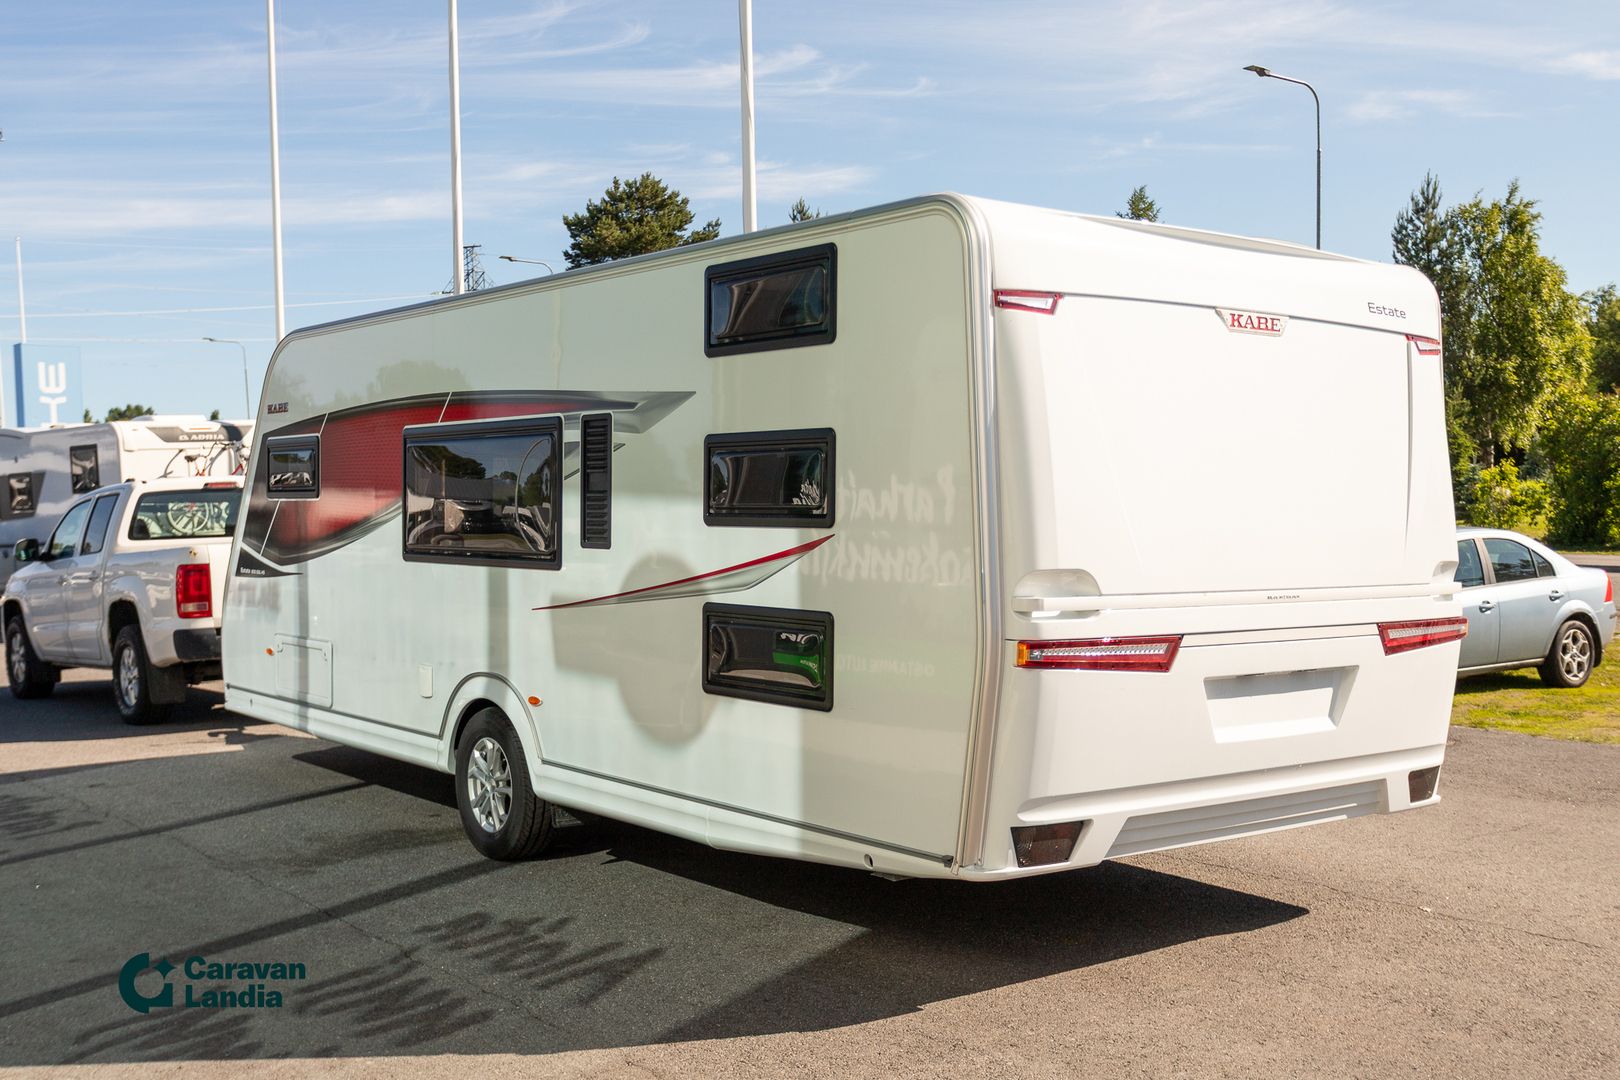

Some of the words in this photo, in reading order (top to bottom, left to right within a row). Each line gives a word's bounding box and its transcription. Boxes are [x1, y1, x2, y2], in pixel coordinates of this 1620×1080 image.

[1367, 302, 1407, 319] Estate
[1229, 313, 1281, 333] KABE
[267, 402, 289, 415] KABE
[191, 433, 225, 441] ADRIA
